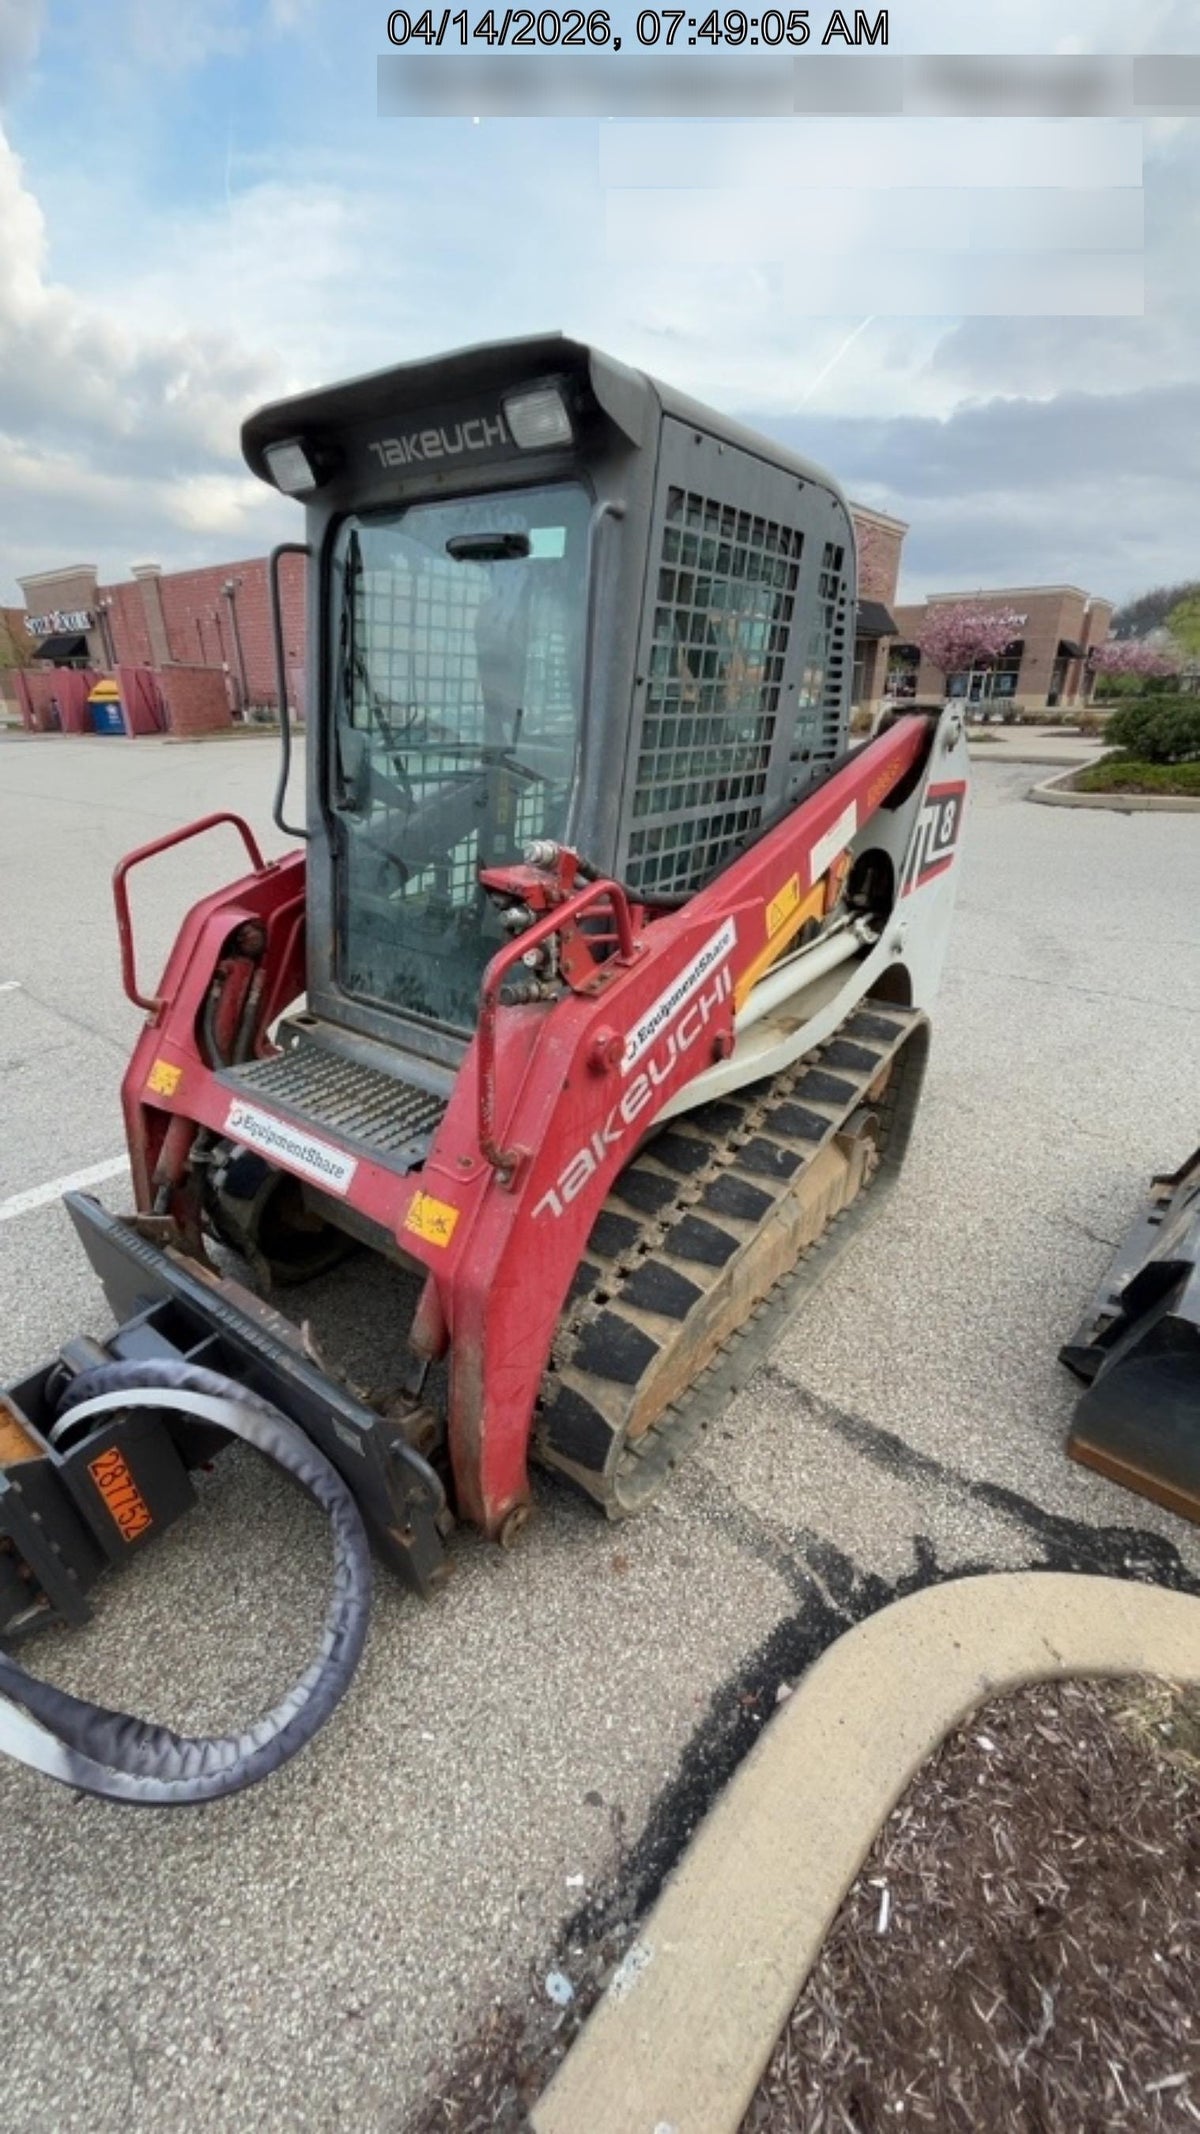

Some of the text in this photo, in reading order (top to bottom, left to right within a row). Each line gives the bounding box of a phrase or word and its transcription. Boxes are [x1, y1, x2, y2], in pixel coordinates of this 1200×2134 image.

[367, 413, 508, 468] TAKEUCH
[637, 932, 731, 1042] EquipmentShare
[243, 1113, 345, 1180] EquipmentShare
[91, 1450, 151, 1540] 287752
